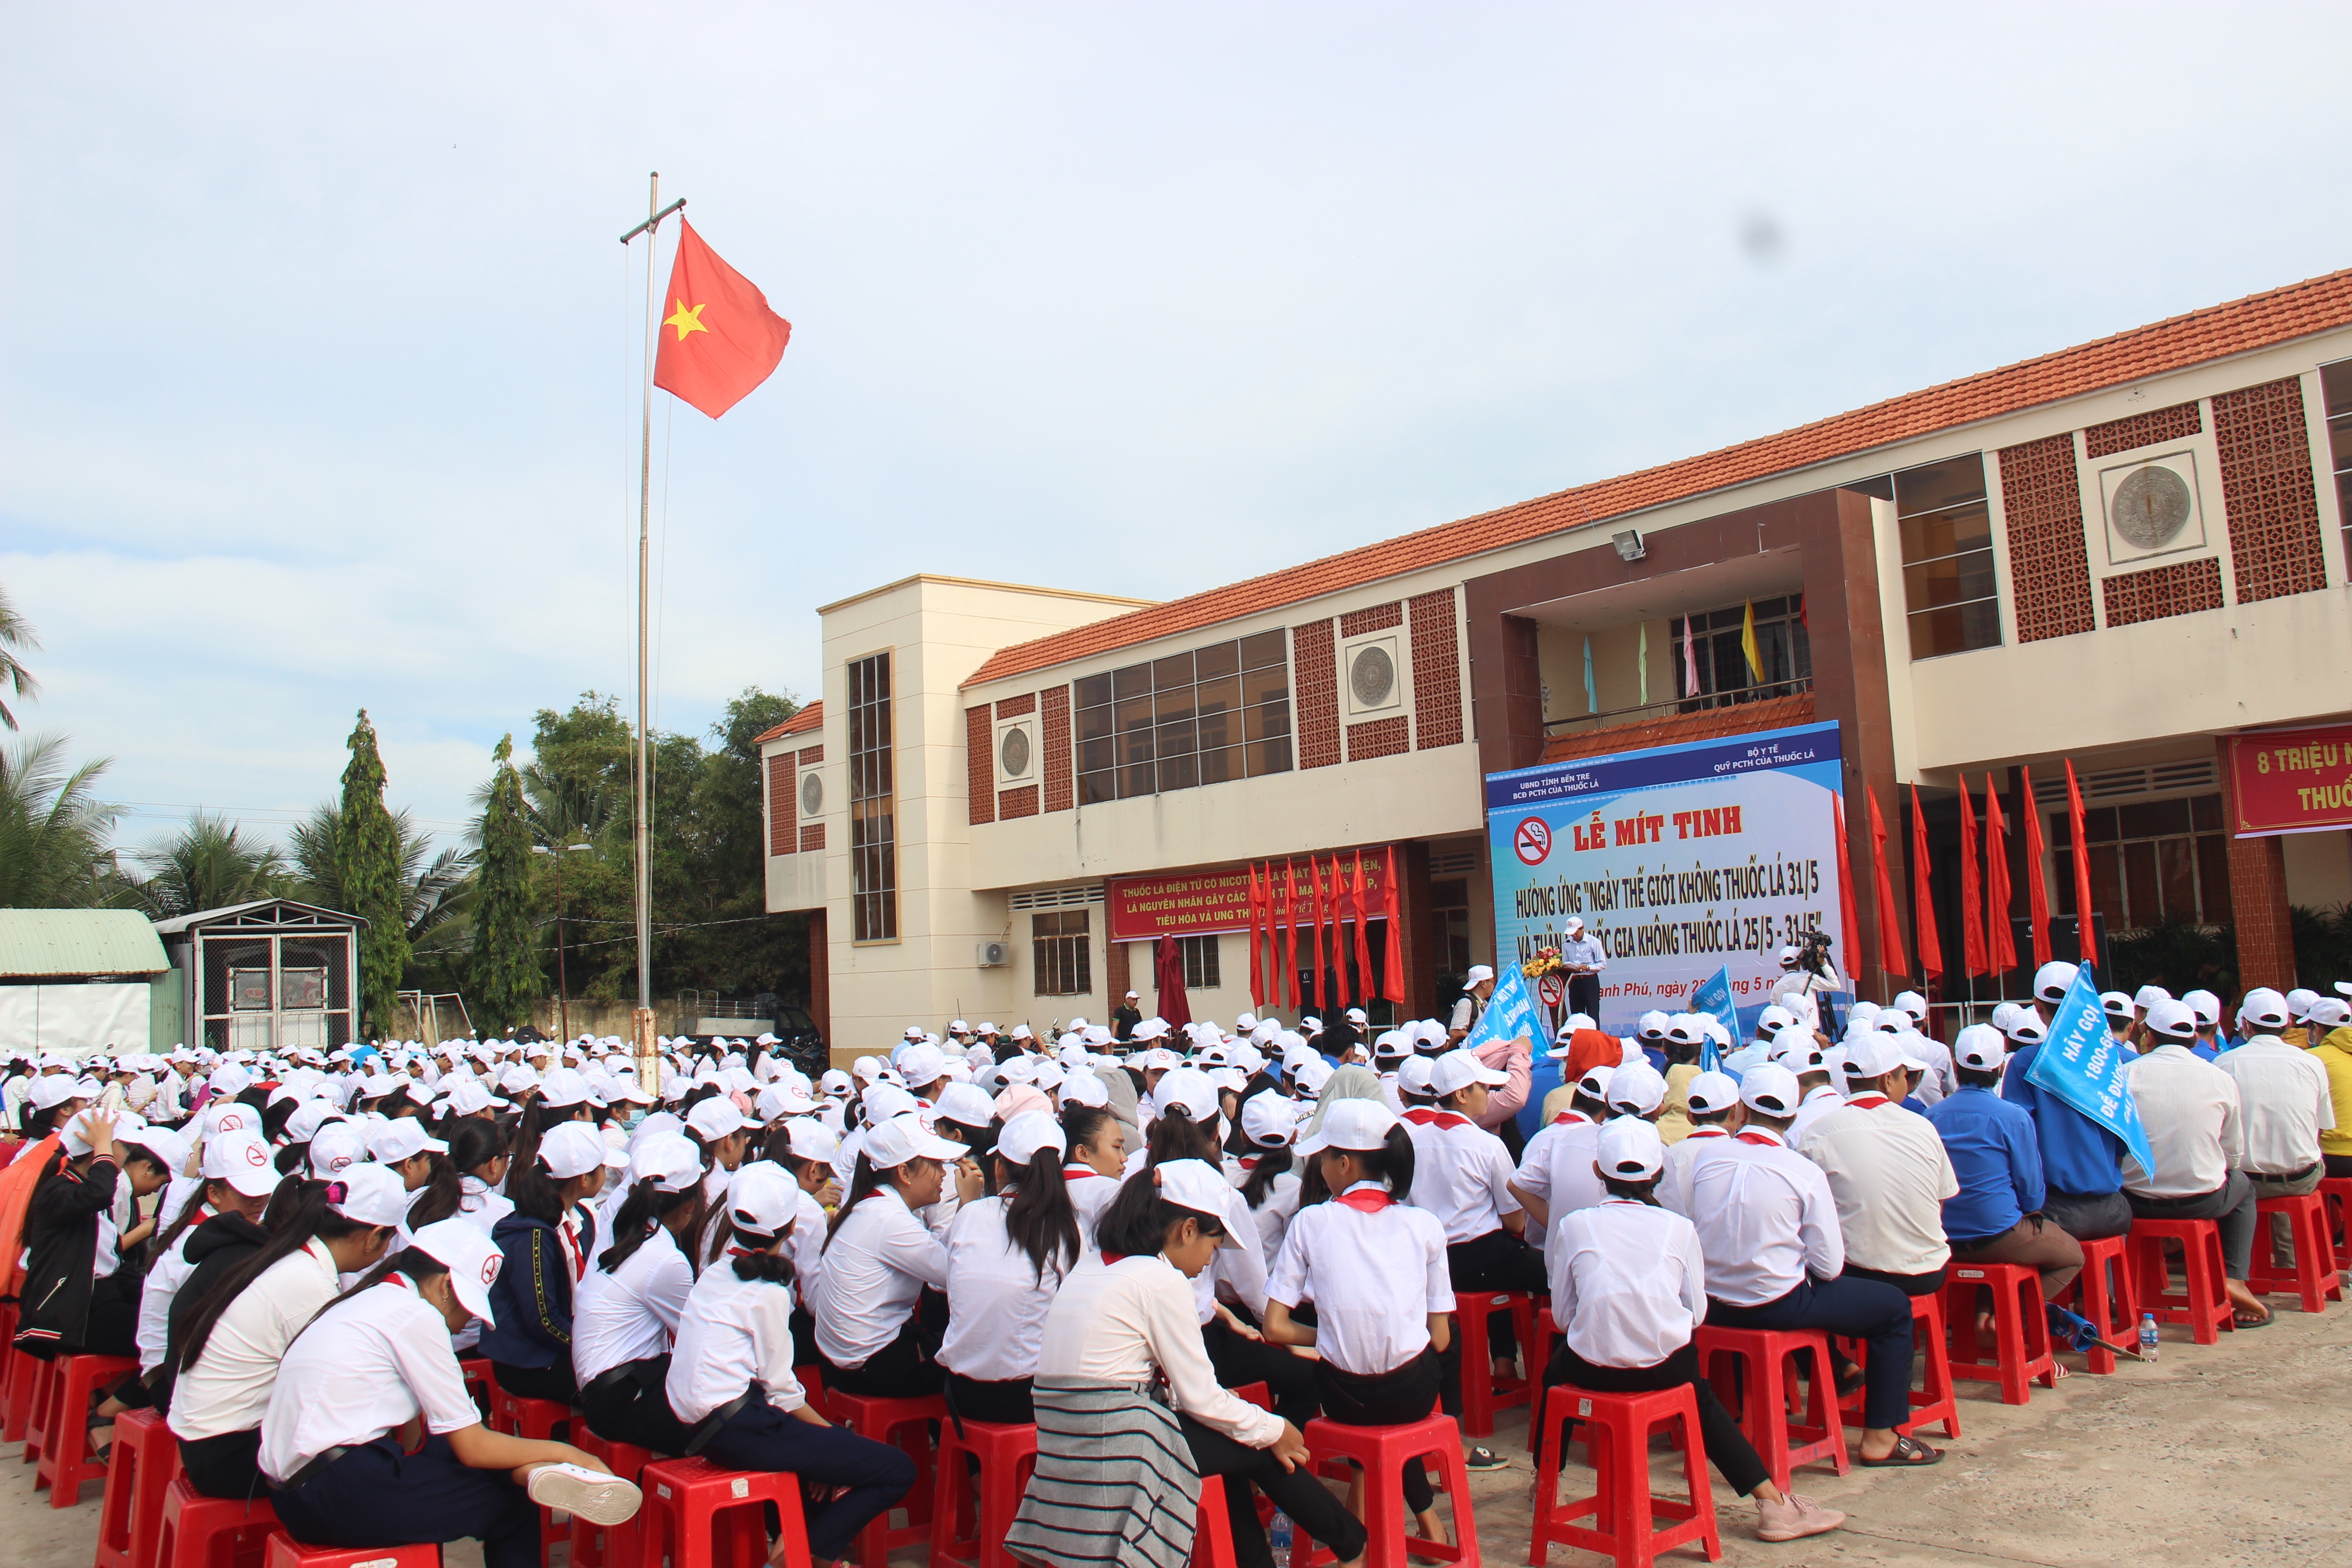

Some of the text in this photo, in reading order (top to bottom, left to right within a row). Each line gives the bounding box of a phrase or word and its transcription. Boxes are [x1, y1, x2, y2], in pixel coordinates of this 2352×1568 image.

[1714, 749, 1815, 773] QUỸ PCTH CỦA THUỐC LÁ
[1747, 746, 1759, 758] BỘ
[1768, 743, 1779, 754] TẾ
[2257, 752, 2269, 774] 8
[2274, 741, 2338, 775] TRIỆU
[1520, 773, 1590, 789] UBND TỈNH BẾN TRE
[1529, 789, 1547, 797] PCTH
[1548, 785, 1563, 794] CỦA
[1563, 781, 1588, 792] THUỐC
[1590, 779, 1599, 788] LÁ
[1573, 805, 1742, 852] LỄ MÍT TINH
[1122, 883, 1151, 898] THUỐC
[1154, 883, 1164, 895] LÁ
[1166, 881, 1187, 895] ĐIỆN
[1190, 877, 1202, 890] TỬ
[1204, 877, 1217, 889] CÓ
[1220, 873, 1264, 887] NICOTIE
[1319, 864, 1333, 876] ÂY
[1515, 877, 1555, 919] HƯỞNG
[1558, 874, 1582, 915] ỨNG
[1622, 866, 1645, 909] THẾ
[1647, 863, 1676, 907] GIỚI
[1678, 860, 1721, 904] KHÔNG
[1723, 854, 1767, 900] THUỐC
[1769, 852, 1786, 897] LÁ
[1788, 859, 1818, 901] 31/5
[1127, 901, 1137, 913] LÀ
[1140, 898, 1175, 912] NGUYÊN
[1178, 895, 1203, 908] NHÂN
[1205, 893, 1224, 906] GÂY
[1227, 890, 1246, 903] CÁC
[1156, 914, 1176, 926] TIÊU
[1178, 911, 1197, 924] HÓA
[1200, 910, 1211, 922] VÀ
[1214, 911, 1234, 921] UNG
[1516, 924, 1532, 965] VÀ
[1614, 927, 1636, 959] GIA
[1637, 913, 1679, 956] KHÔNG
[1681, 909, 1723, 954] THUỐC
[1725, 907, 1741, 951] LÁ
[1744, 916, 1773, 956] 25/5
[1598, 984, 1620, 1001] ạnh
[1623, 981, 1652, 997] Phú,
[1656, 980, 1688, 998] ngày
[1754, 976, 1762, 990] 5
[2062, 1004, 2101, 1062] HÃY GỌI
[2084, 1023, 2114, 1080] 1800-66
[2097, 1091, 2119, 1119] ĐỂ
